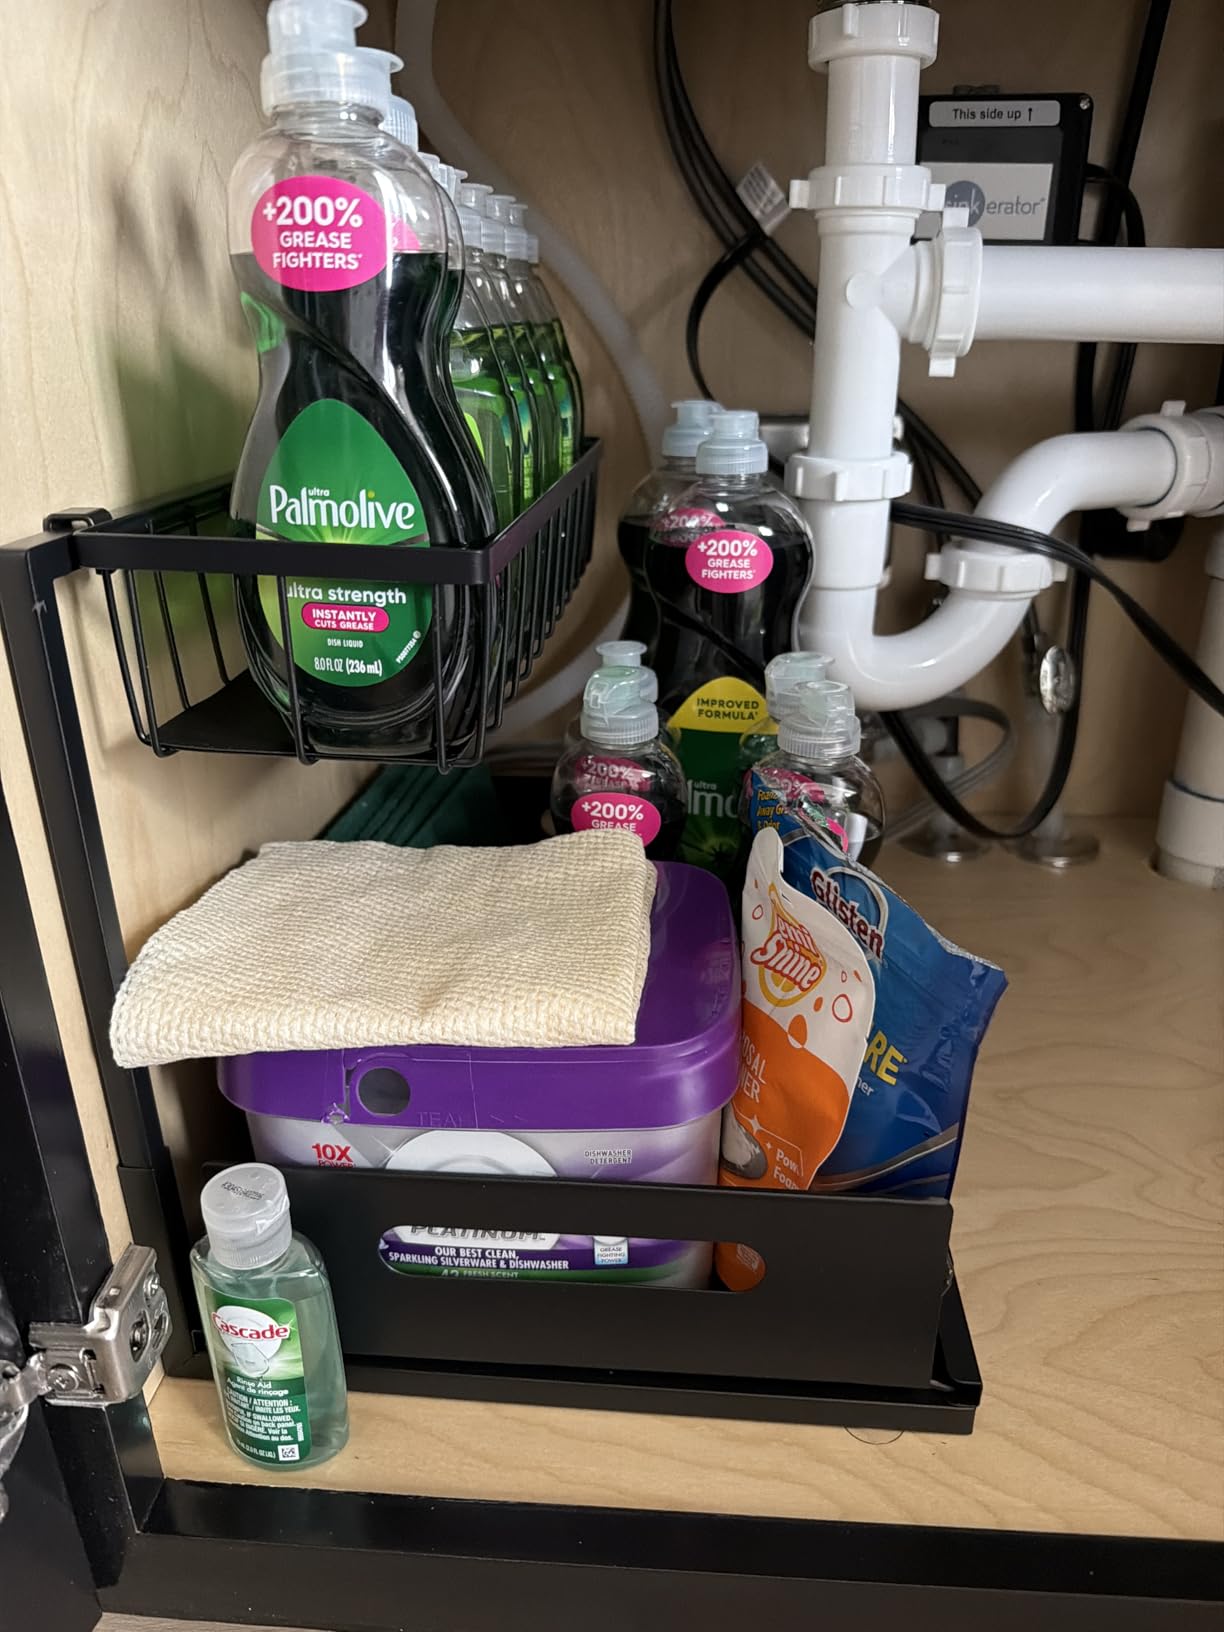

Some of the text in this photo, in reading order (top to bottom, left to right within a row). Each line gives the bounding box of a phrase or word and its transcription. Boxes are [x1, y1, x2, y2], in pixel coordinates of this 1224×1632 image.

[953, 108, 1021, 121] This side up
[263, 196, 363, 228] +200%
[280, 231, 352, 249] GREASE
[307, 487, 330, 497] ultra
[269, 484, 415, 530] Palmolive
[697, 539, 758, 557] +200%
[707, 558, 750, 569] GREASE
[328, 587, 406, 607] strength
[312, 608, 376, 622] INSTANTLY
[314, 620, 374, 631] CUTS GREASE
[327, 638, 363, 648] DISH LIQUID
[366, 660, 382, 676] mL)
[697, 698, 759, 710] IMPROVED
[582, 801, 644, 820] +200%
[811, 868, 885, 959] Glisten
[750, 929, 822, 992] Shine
[863, 1029, 904, 1086] RE
[311, 1143, 353, 1162] 10X
[584, 1149, 632, 1157] DISHWASHER
[388, 1251, 569, 1269] SPARKLING SILVERWARE & DISHWASHER
[434, 1246, 519, 1260] OUR BEST CLEAN,
[211, 1311, 289, 1340] Cascade
[257, 1381, 272, 1389] Aid
[253, 1397, 288, 1407] ATTENTION
